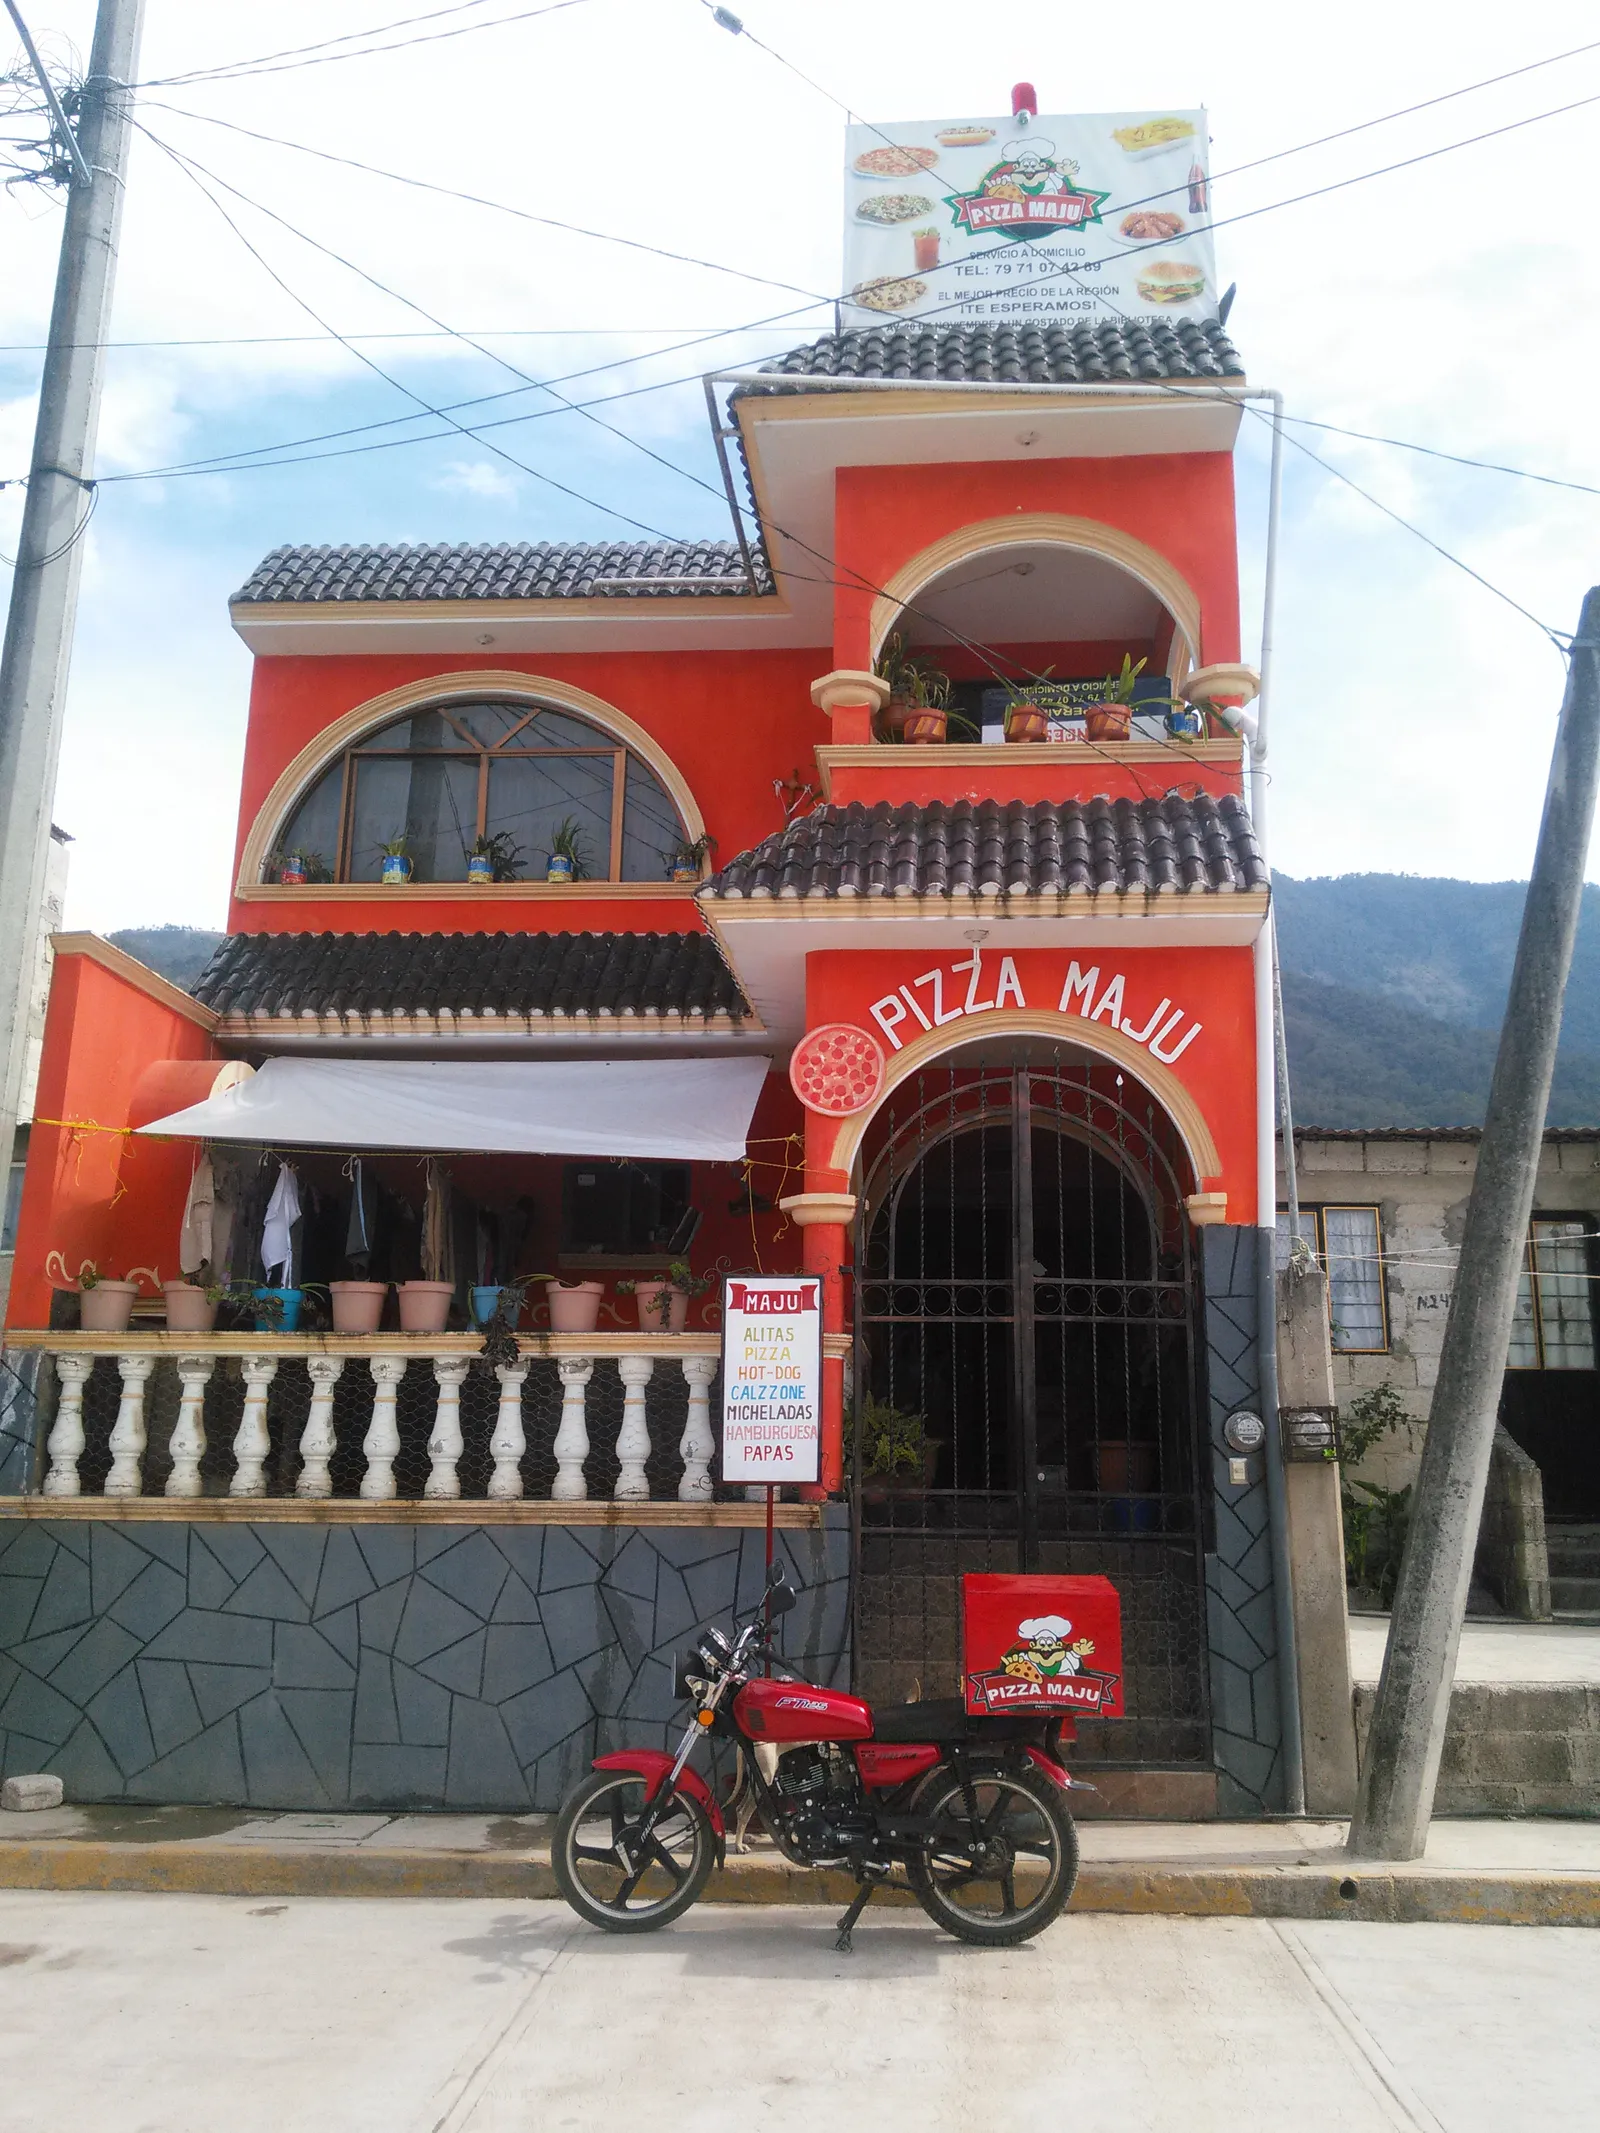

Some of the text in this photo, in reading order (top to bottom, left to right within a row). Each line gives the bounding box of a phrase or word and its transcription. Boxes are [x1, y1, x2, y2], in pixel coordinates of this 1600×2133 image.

[971, 201, 1080, 224] PIZZA MAJU
[970, 248, 1085, 259] SERVICIO A DOMICILIO
[954, 266, 988, 276] TEL:
[995, 264, 1012, 274] 79
[1017, 263, 1032, 273] 71
[1039, 262, 1056, 272] 07
[1061, 262, 1078, 273] 42
[938, 285, 1119, 300] EL MEJOR PRECIO DE LA REGIÓN
[991, 300, 1097, 313] ESPERAMOS!
[869, 957, 1202, 1064] PIZZA MAJU
[746, 1294, 798, 1311] MAJU
[743, 1327, 794, 1342] ALITAS
[745, 1347, 791, 1361] PIZZA
[738, 1366, 801, 1380] HOT-DOG
[731, 1385, 806, 1400] CALZZONE
[727, 1405, 812, 1420] MICHELADAS
[726, 1425, 818, 1440] HAMBURGUESA
[743, 1445, 794, 1461] PAPAS
[987, 1683, 1100, 1701] PIZZA MAJU
